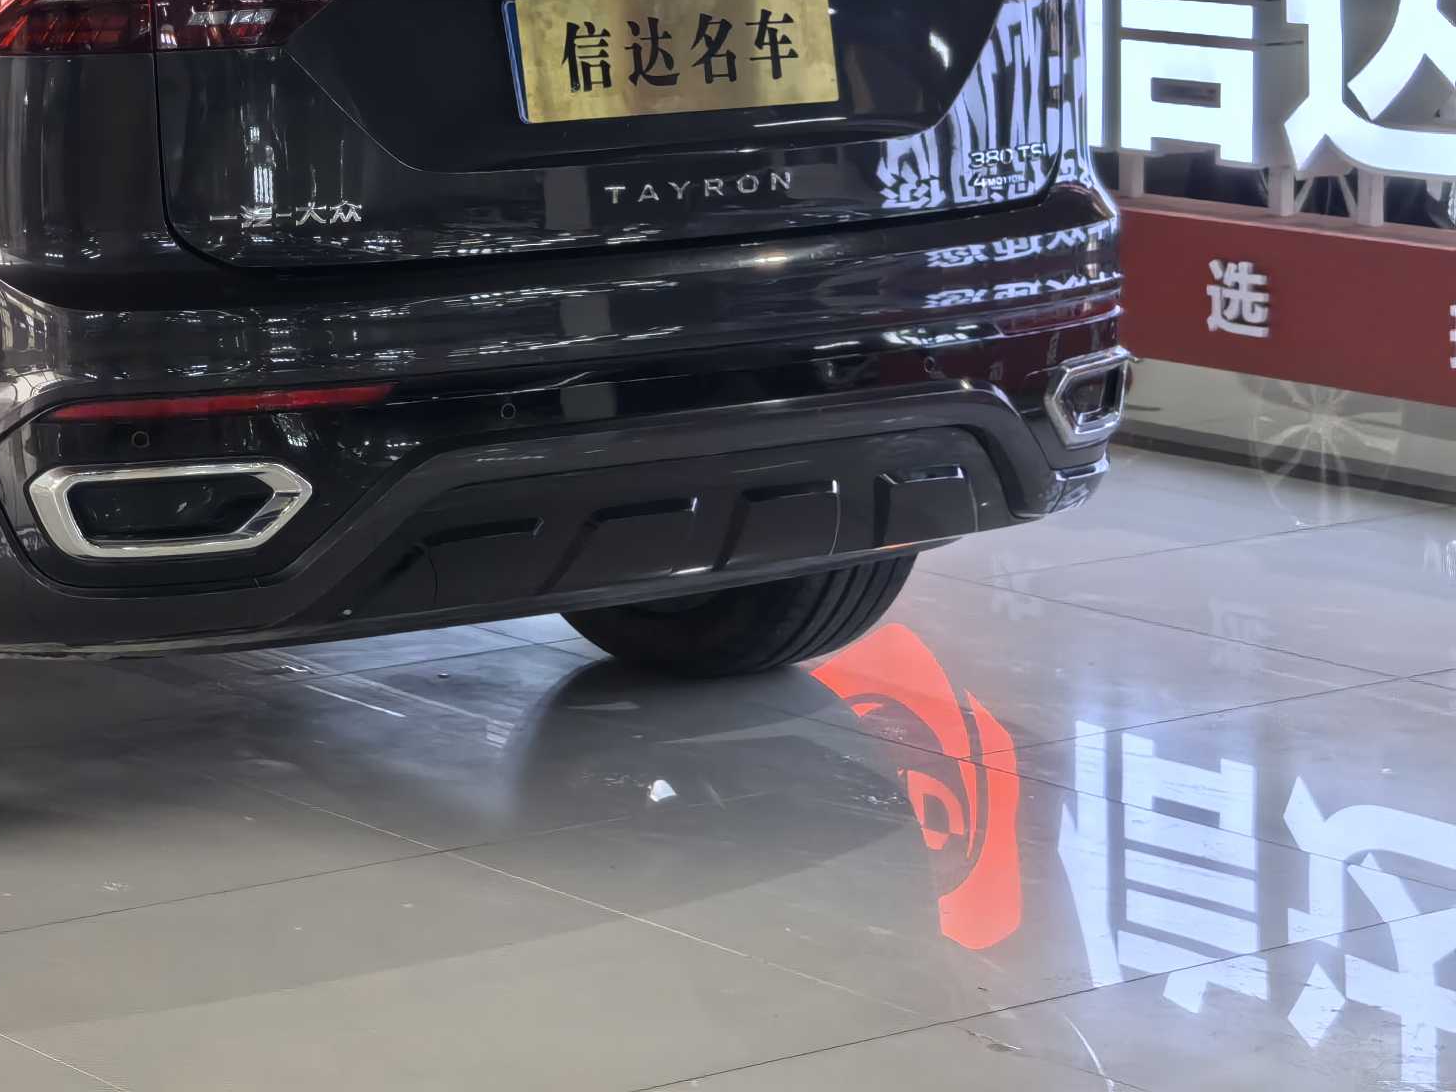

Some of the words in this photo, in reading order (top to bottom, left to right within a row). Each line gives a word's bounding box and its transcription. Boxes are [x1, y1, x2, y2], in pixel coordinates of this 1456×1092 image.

[562, 9, 799, 92] 信达名车
[970, 147, 1013, 168] 380
[604, 171, 791, 204] TAYRON
[210, 200, 362, 228] 一汽-大众
[1206, 259, 1270, 338] 选
